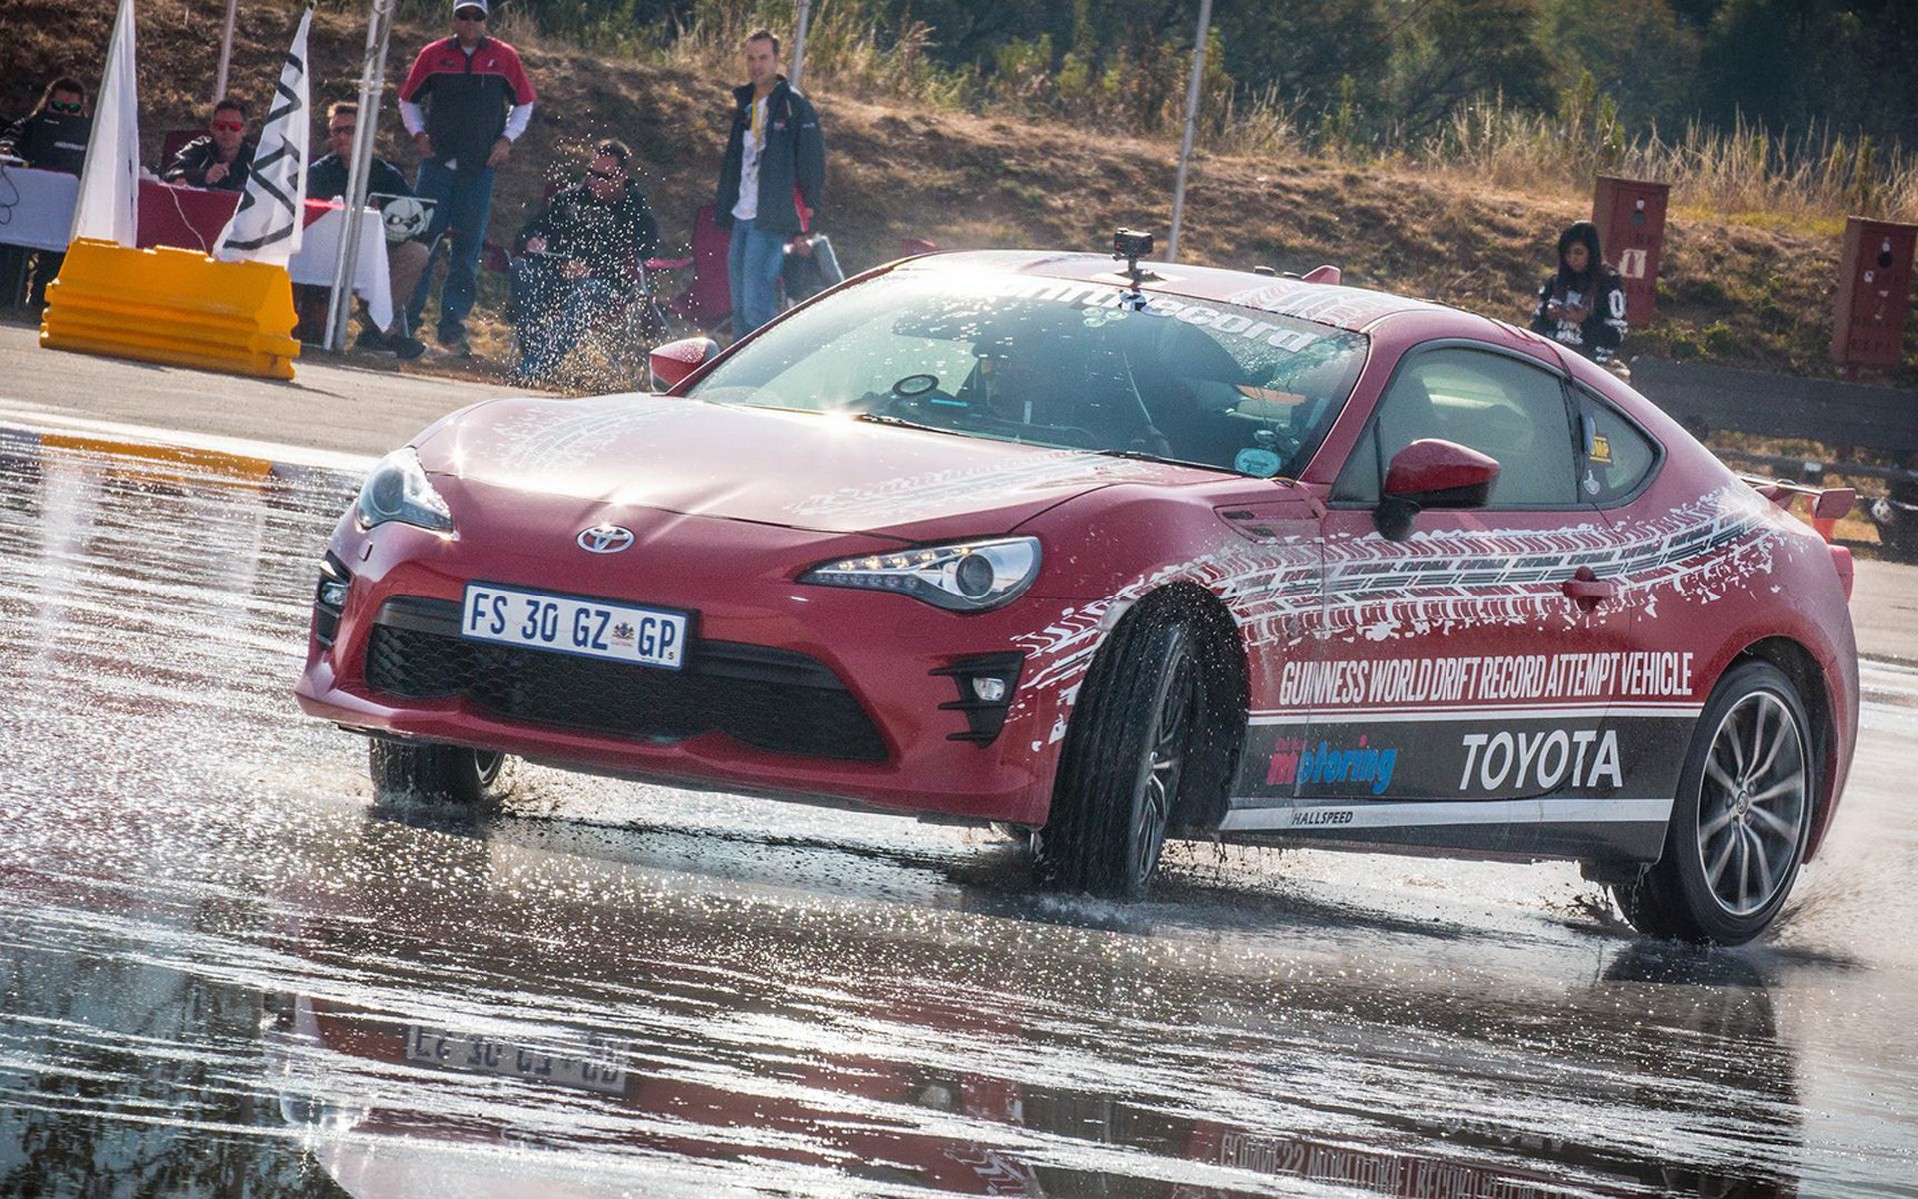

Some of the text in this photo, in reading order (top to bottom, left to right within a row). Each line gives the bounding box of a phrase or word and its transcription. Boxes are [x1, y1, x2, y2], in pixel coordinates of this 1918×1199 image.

[471, 593, 676, 659] FS 30 GZ GP
[1279, 651, 1694, 706] GUINNESS WORLD DRIFT RECORD ATTEMPT VEHICLE
[1459, 730, 1623, 791] TOYOTA
[1292, 811, 1354, 826] HALLSPEED
